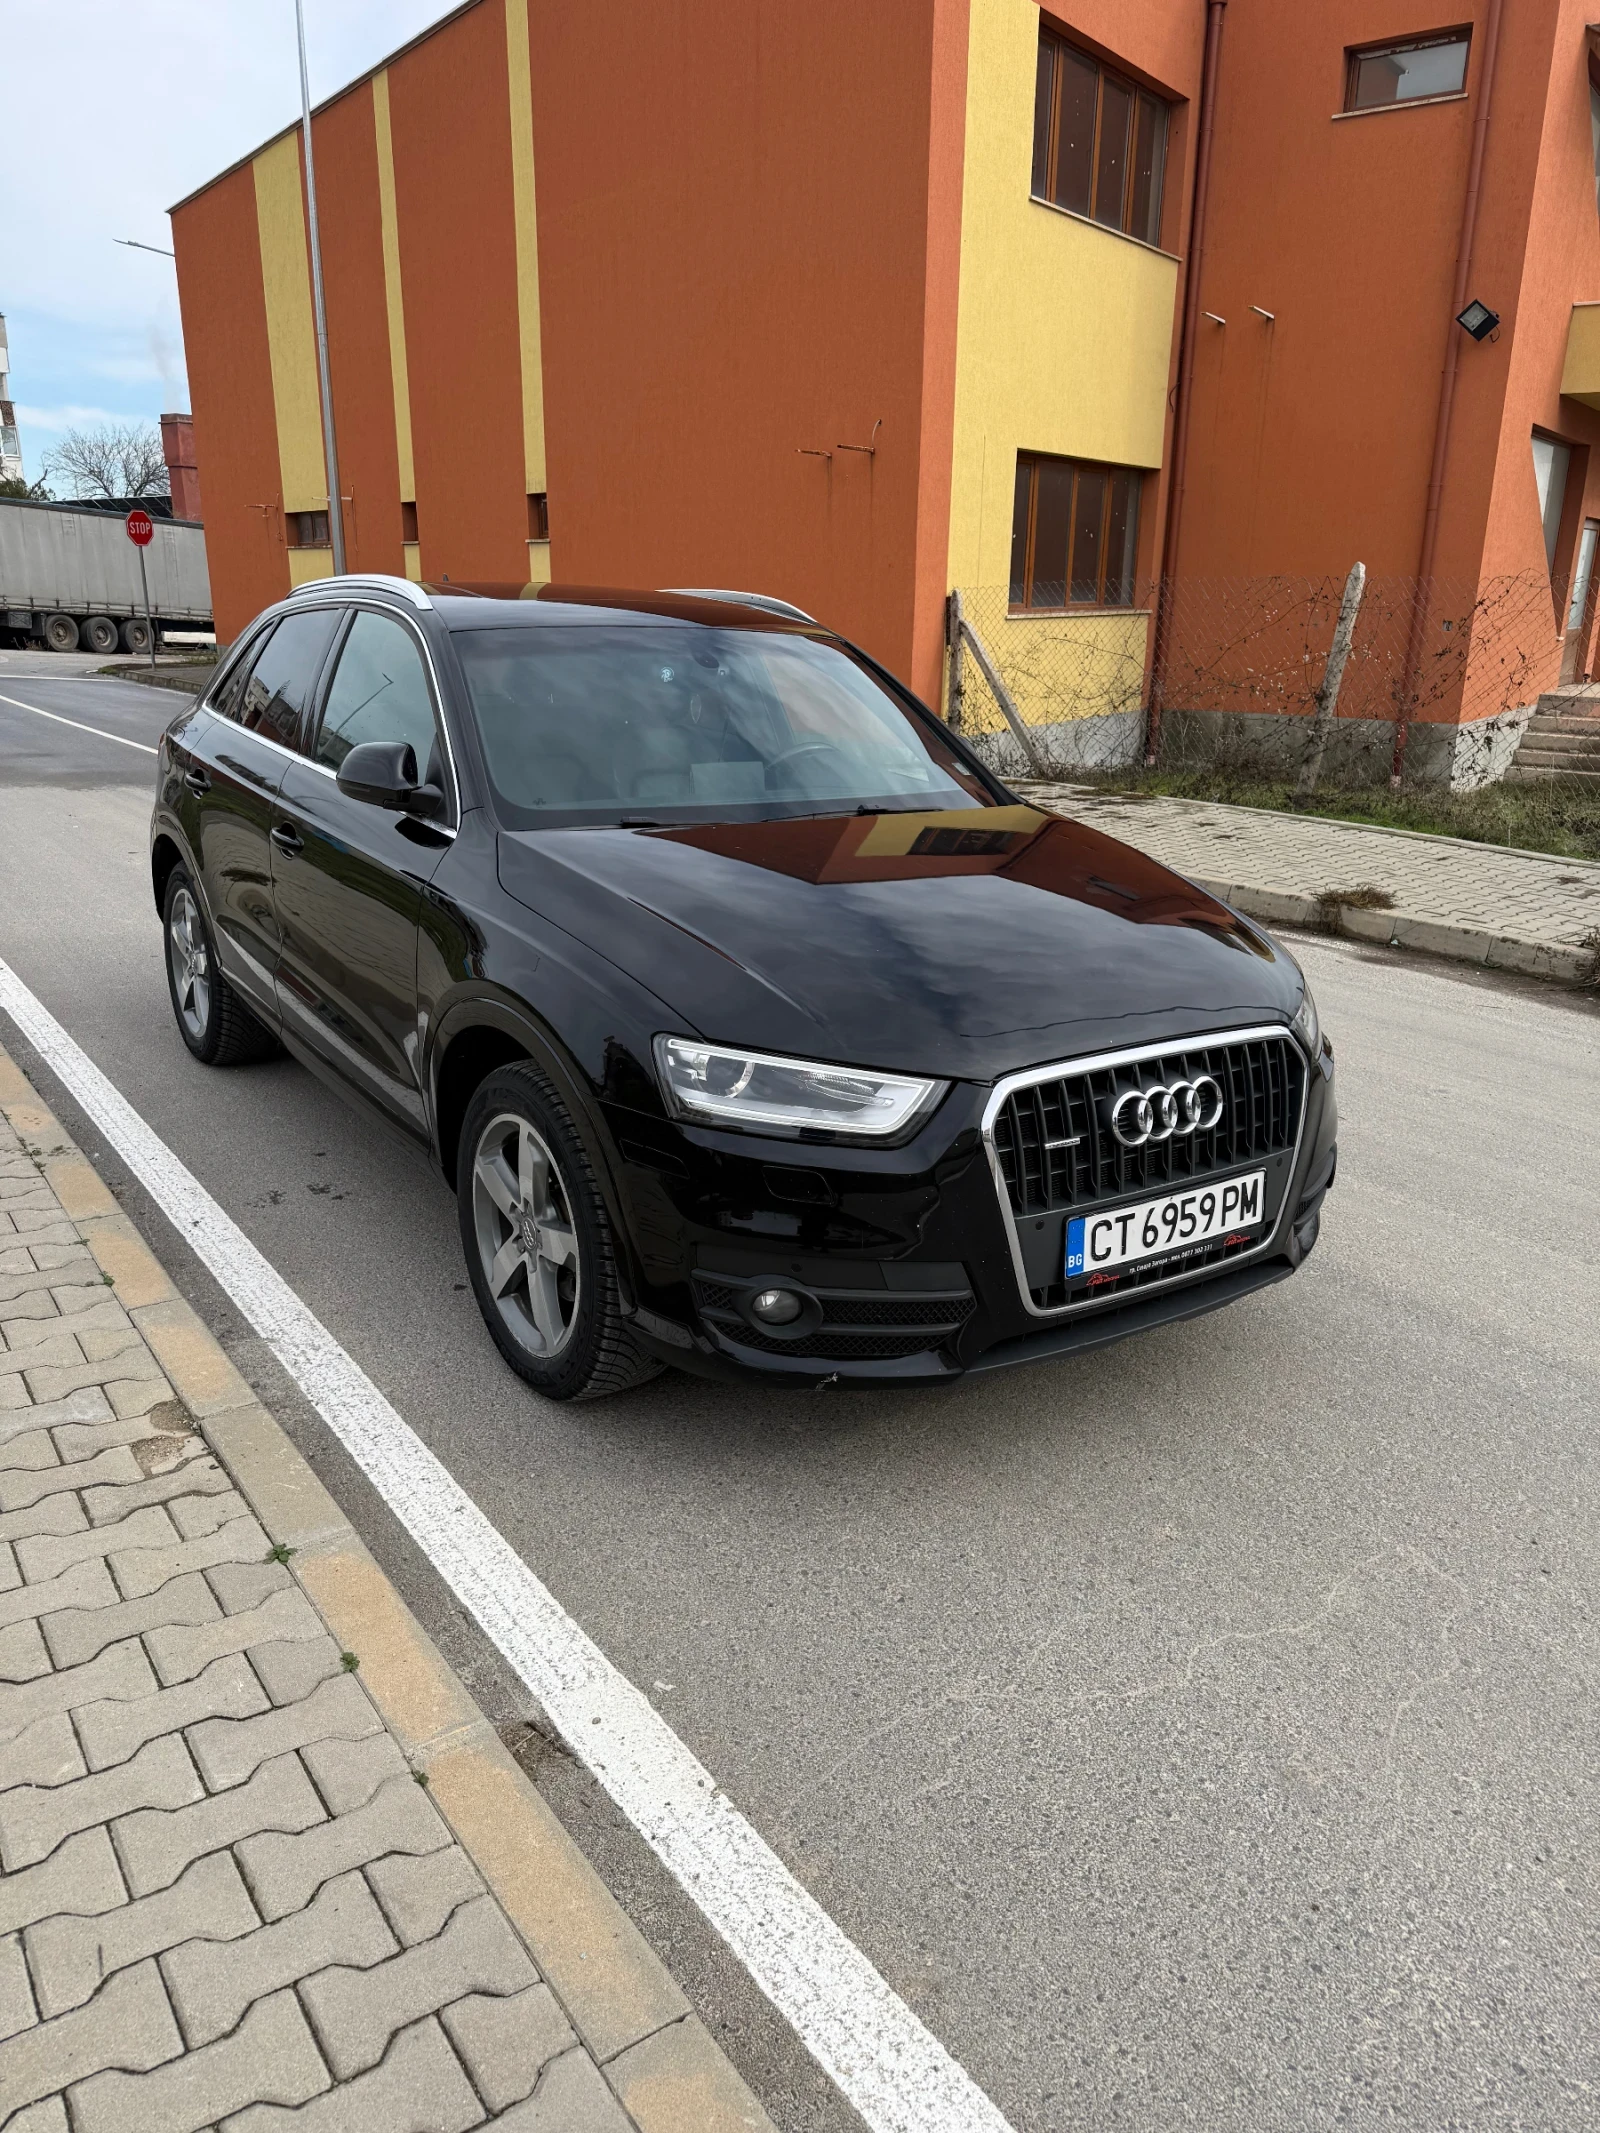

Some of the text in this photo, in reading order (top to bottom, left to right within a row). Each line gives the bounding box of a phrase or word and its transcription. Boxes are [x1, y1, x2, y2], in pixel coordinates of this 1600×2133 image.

[130, 522, 150, 534] STOP
[1090, 1178, 1259, 1261] CT 6959 PM
[1068, 1253, 1082, 1268] BG
